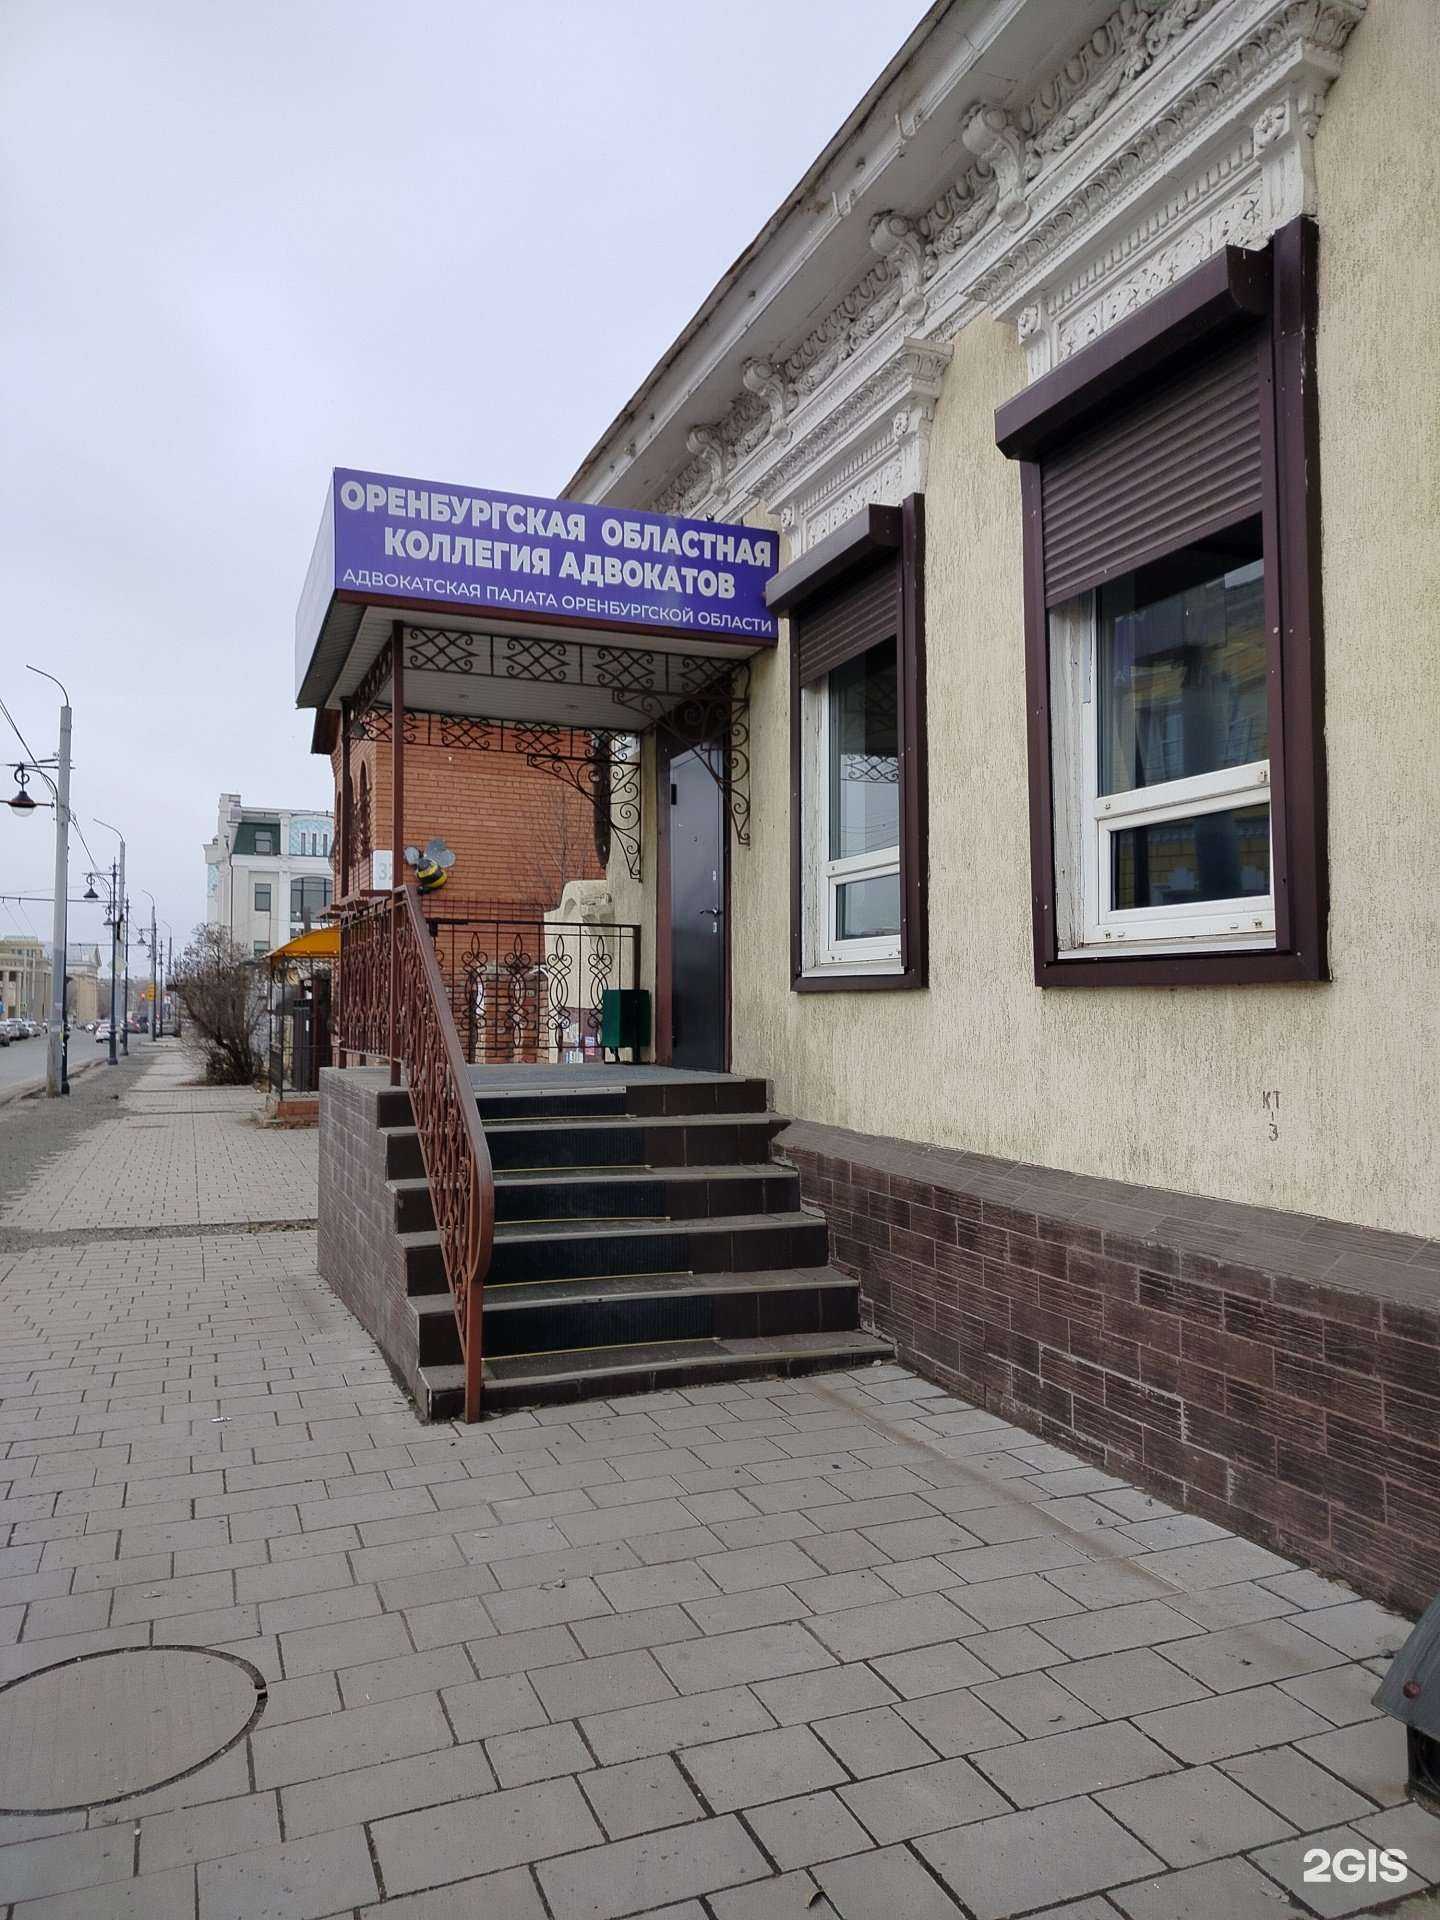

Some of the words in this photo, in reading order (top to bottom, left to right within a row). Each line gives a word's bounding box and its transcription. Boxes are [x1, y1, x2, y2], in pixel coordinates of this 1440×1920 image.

[340, 480, 585, 542] ОРЕНБУРГСКАЯ
[601, 518, 771, 568] ОБЛАСТНАЯ
[384, 526, 550, 576] КОЛЛЕГИЯ
[558, 551, 736, 599] АДВОКАТОВ
[343, 568, 481, 598] АДВОКАТСКАЯ
[486, 585, 558, 608] ПАЛАТА
[561, 595, 694, 624] ОРЕНБУРГСКОЙ
[697, 613, 772, 633] ОБЛАСТИ
